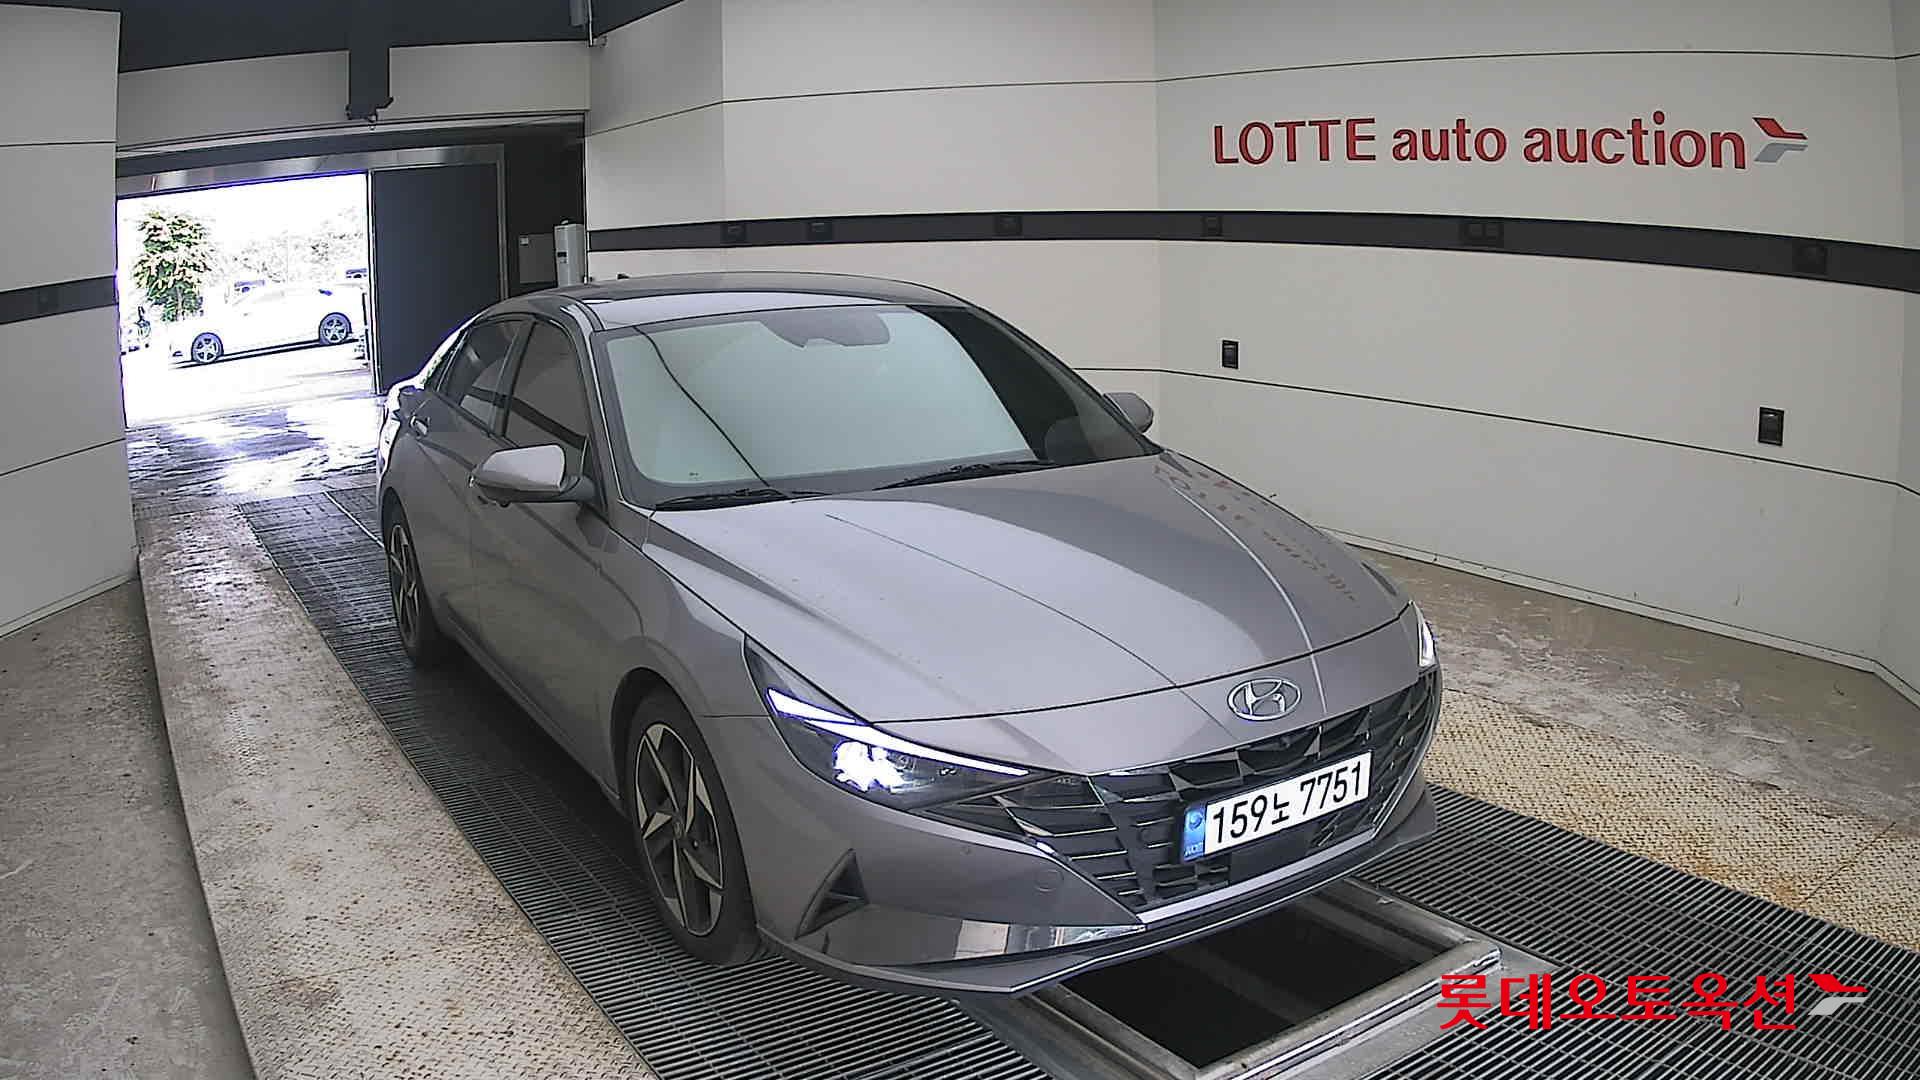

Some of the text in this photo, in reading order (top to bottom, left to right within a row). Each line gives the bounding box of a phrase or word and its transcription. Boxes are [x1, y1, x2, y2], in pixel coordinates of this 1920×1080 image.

[1213, 110, 1746, 170] LOTTE auto auction
[1213, 761, 1361, 843] 159노 7751
